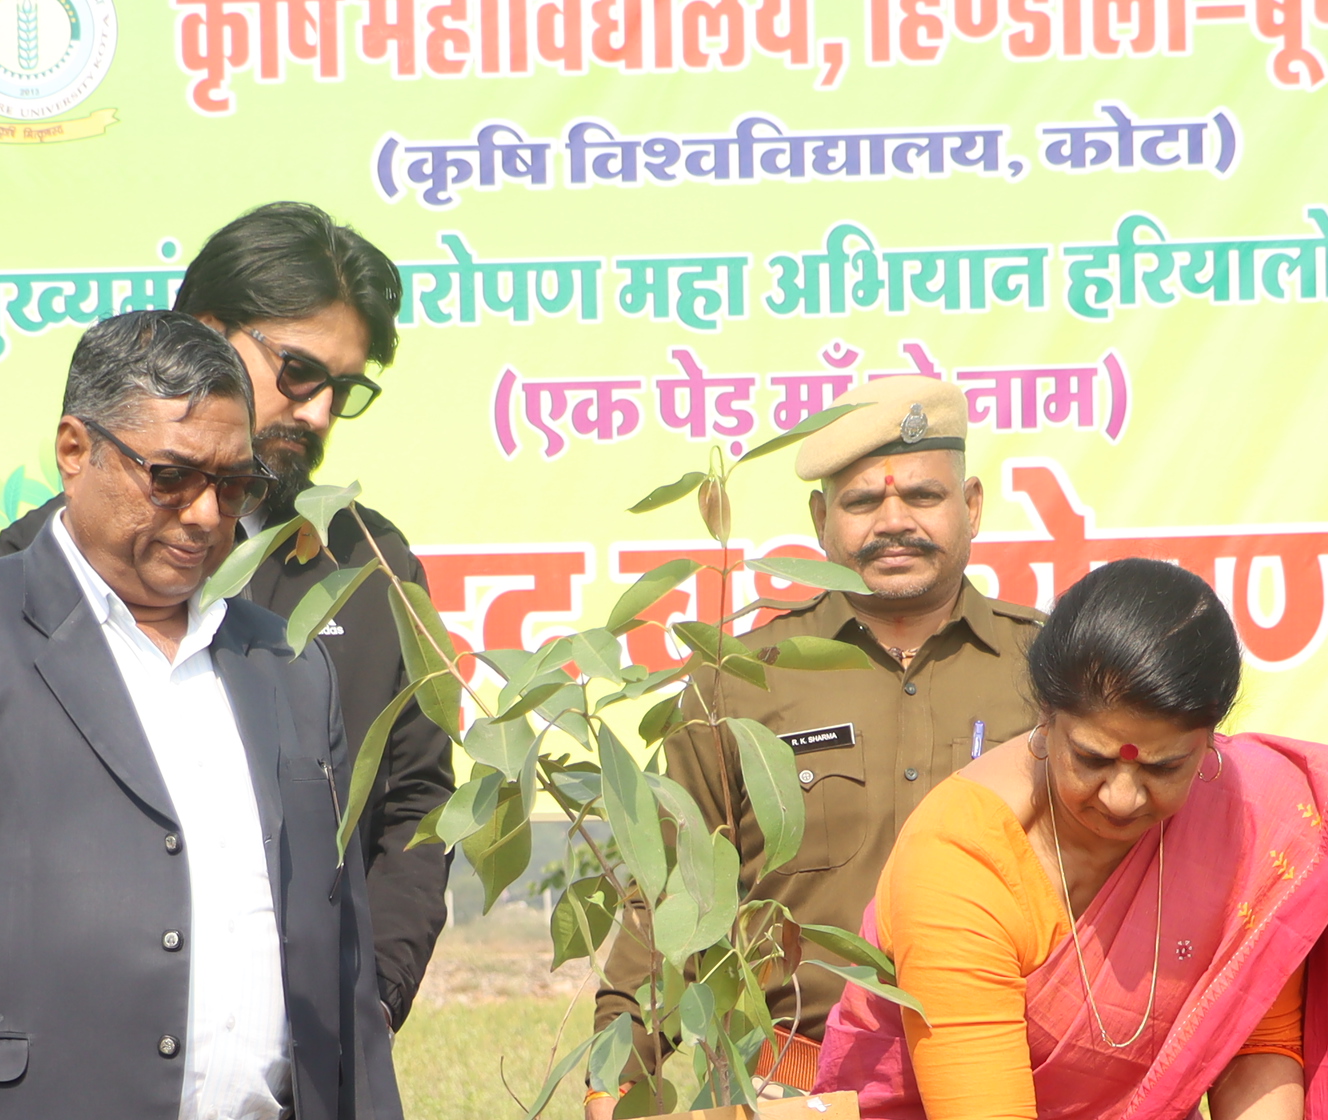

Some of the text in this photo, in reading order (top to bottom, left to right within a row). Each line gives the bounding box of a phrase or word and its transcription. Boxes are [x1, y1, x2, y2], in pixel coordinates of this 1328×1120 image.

[20, 73, 94, 117] UNIVERSITY
[92, 14, 111, 70] KOTA
[376, 104, 1238, 205] (कृषि विश्वविद्यालय, कोटा)
[617, 257, 749, 329] महा
[766, 224, 1049, 315] अभियान
[493, 368, 642, 457] (एक
[656, 349, 756, 456] पेड़
[809, 732, 837, 743] SHARMA
